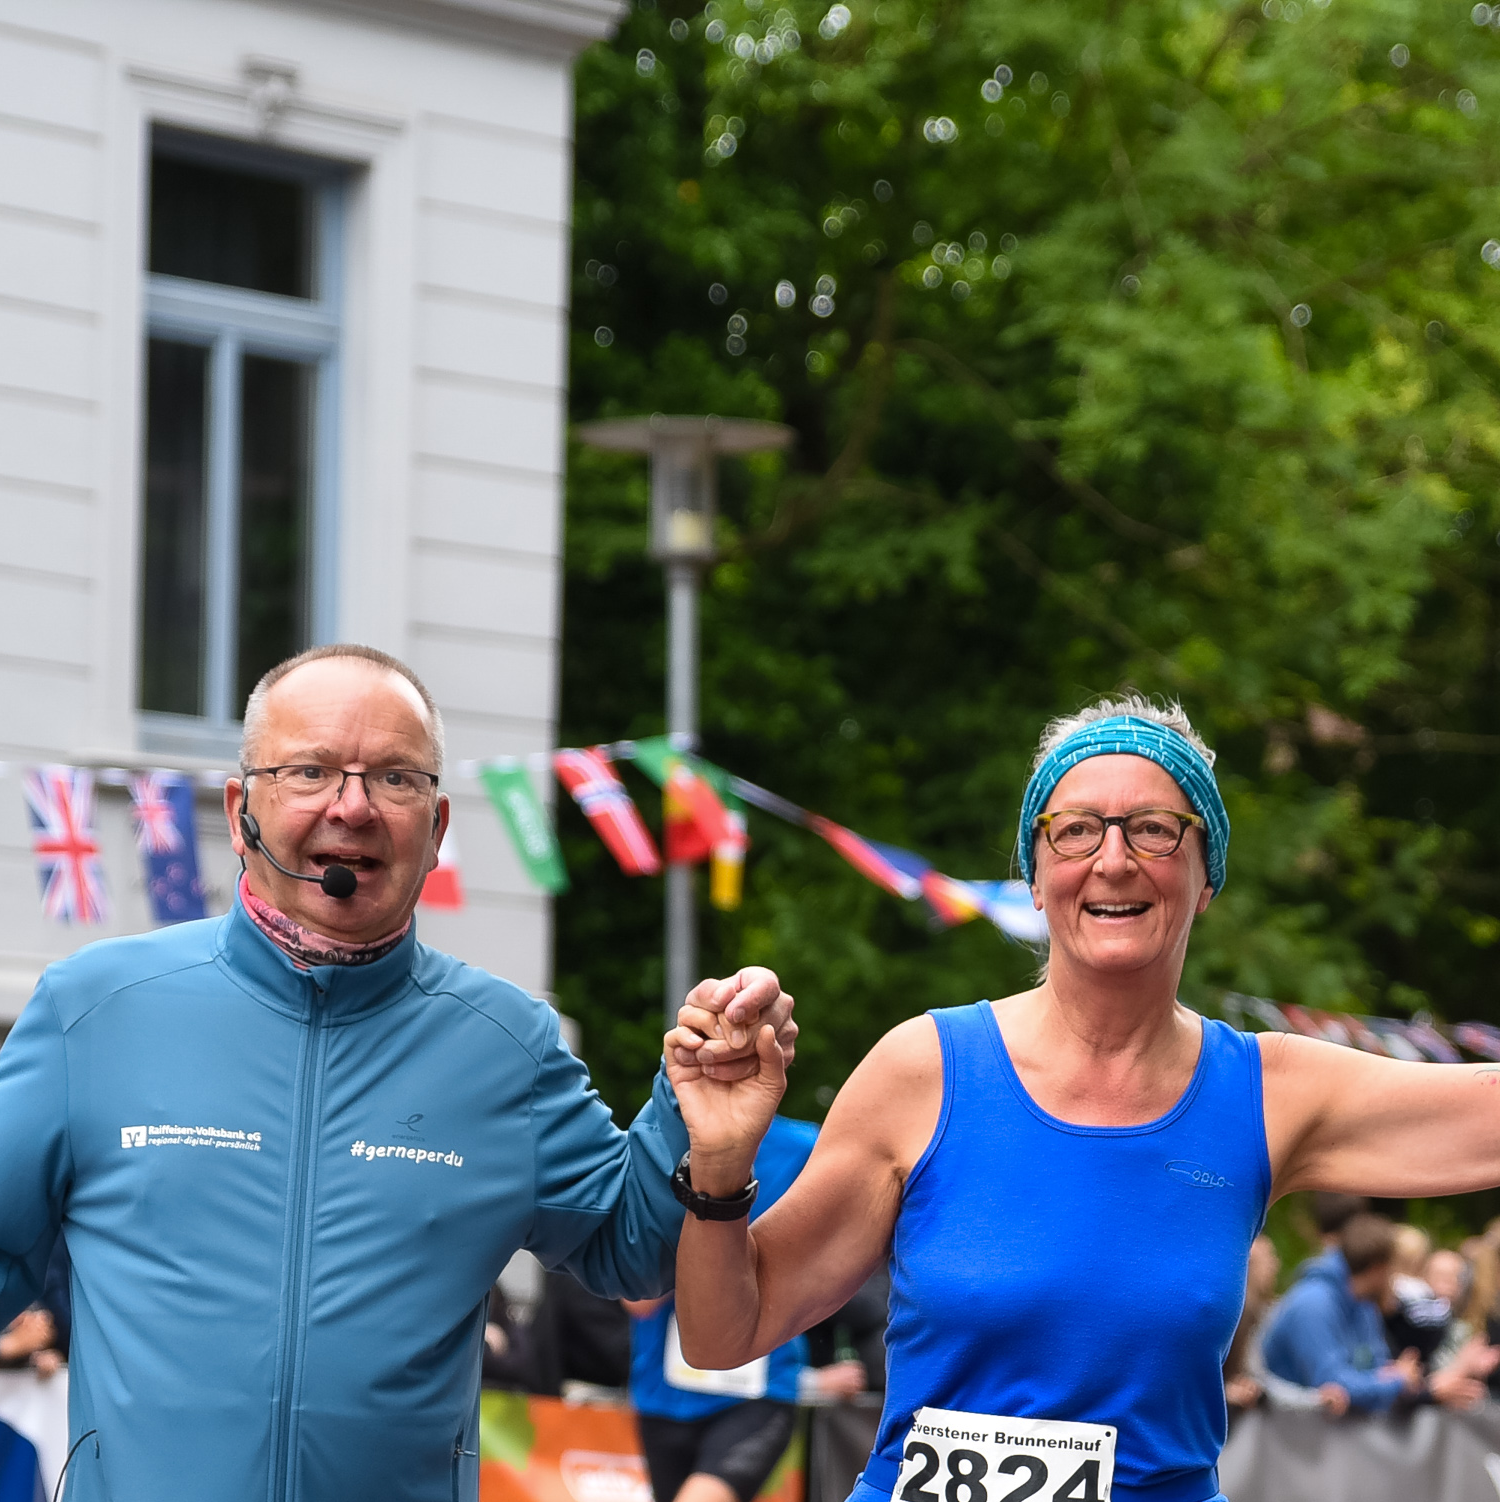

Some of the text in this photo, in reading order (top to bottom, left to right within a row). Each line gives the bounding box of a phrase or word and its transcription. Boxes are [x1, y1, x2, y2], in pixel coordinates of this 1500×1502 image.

[148, 1124, 262, 1142] Raiffeisen-Volksbank eG
[350, 1140, 464, 1167] #gerneperdu
[994, 1431, 1102, 1452] Brunnenlauf
